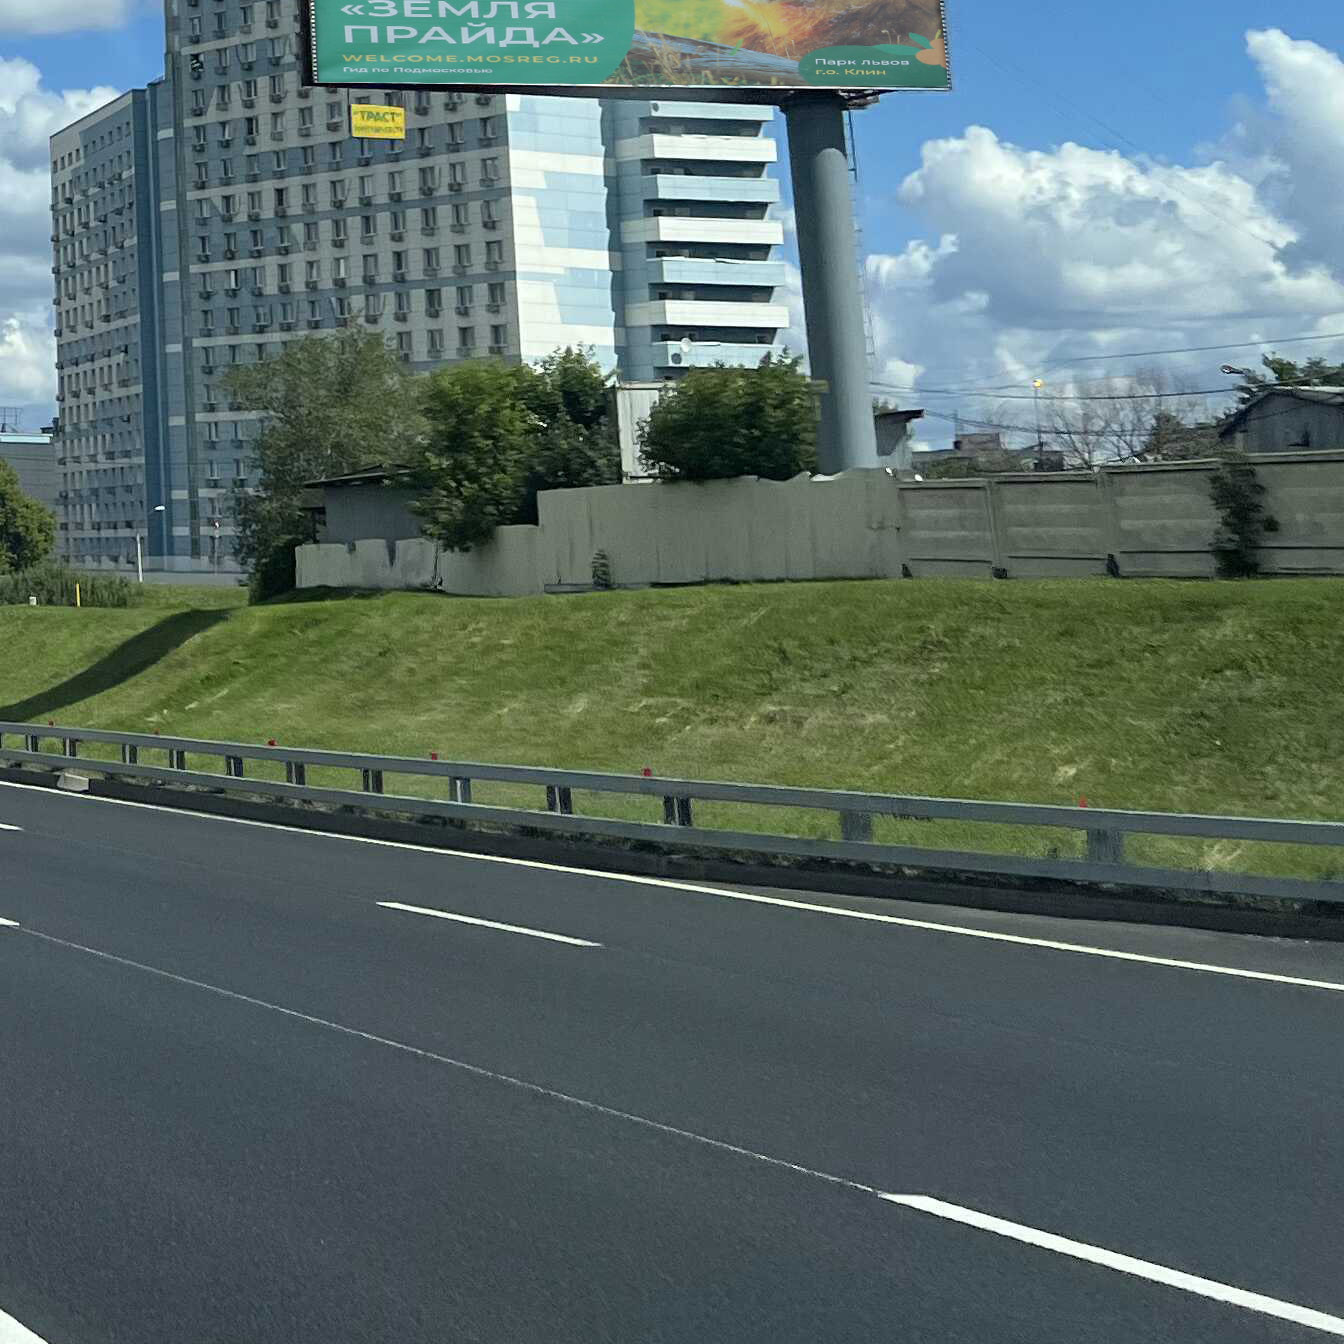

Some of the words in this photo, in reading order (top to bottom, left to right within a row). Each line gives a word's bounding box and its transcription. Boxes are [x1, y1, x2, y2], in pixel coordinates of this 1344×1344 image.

[340, 0, 556, 19] «ЗЕМЛЯ
[344, 22, 605, 48] ПРАЙДА»
[342, 54, 598, 64] WELCOME.MOSREG.RU
[815, 58, 857, 67] Парк
[844, 68, 886, 76] Клин
